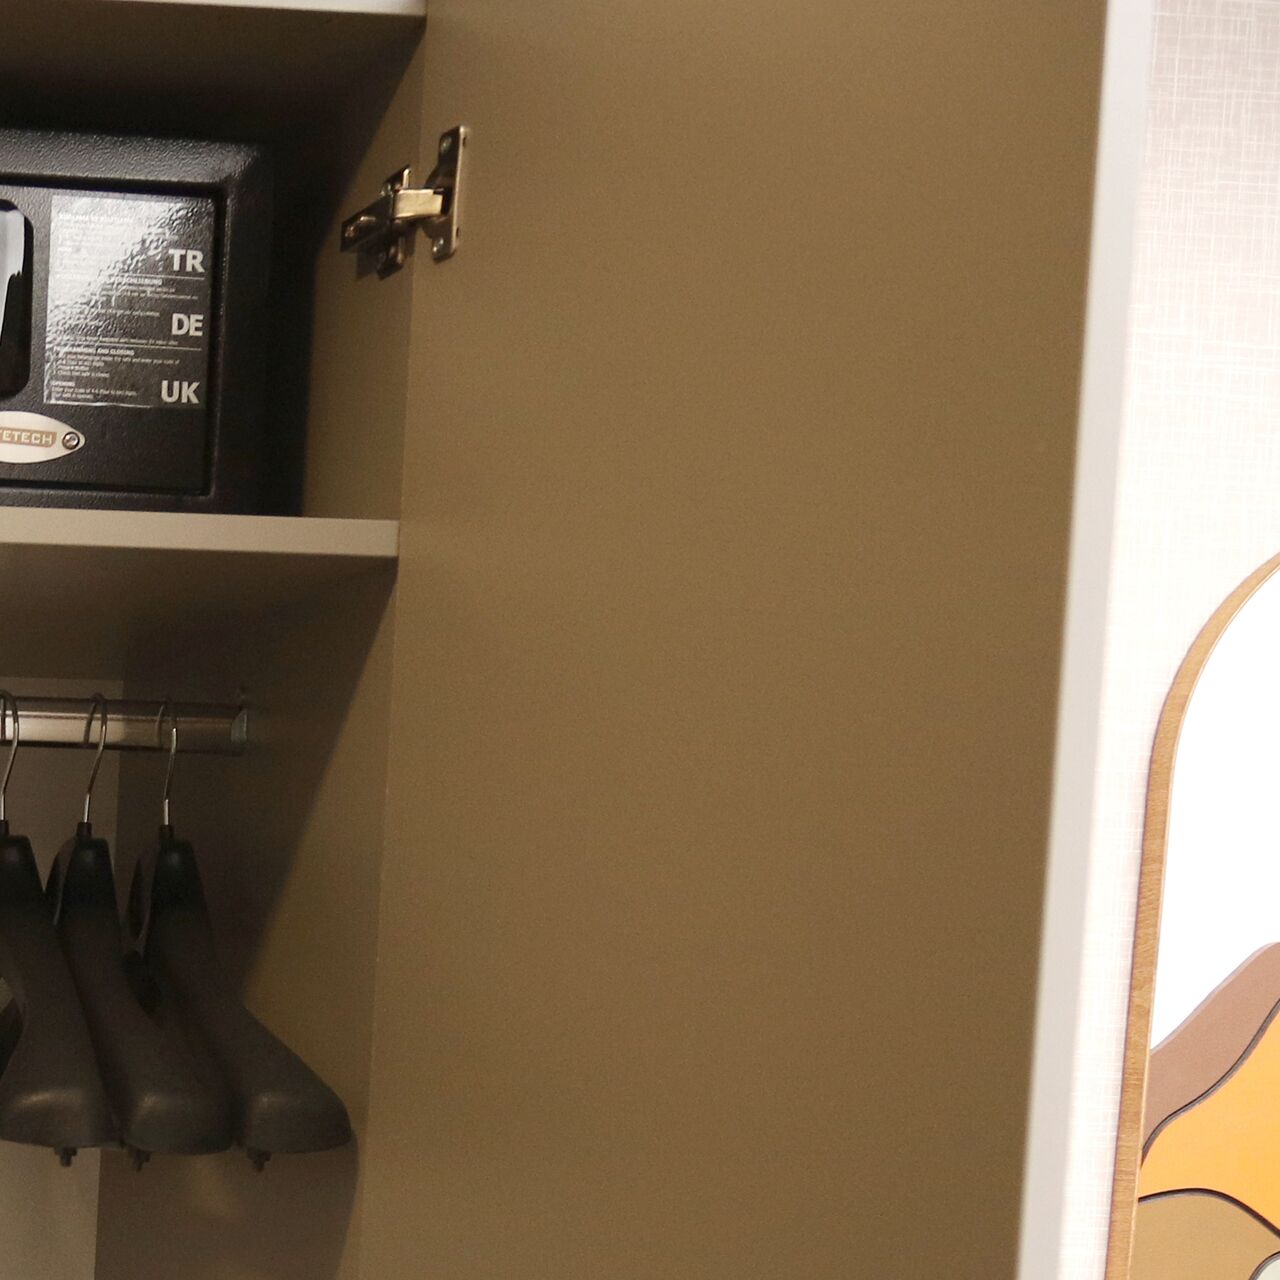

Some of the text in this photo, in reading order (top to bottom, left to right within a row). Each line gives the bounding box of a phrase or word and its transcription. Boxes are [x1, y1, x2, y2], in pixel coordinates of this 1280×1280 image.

[168, 248, 205, 273] TR
[171, 313, 204, 337] DE
[161, 380, 201, 404] UK
